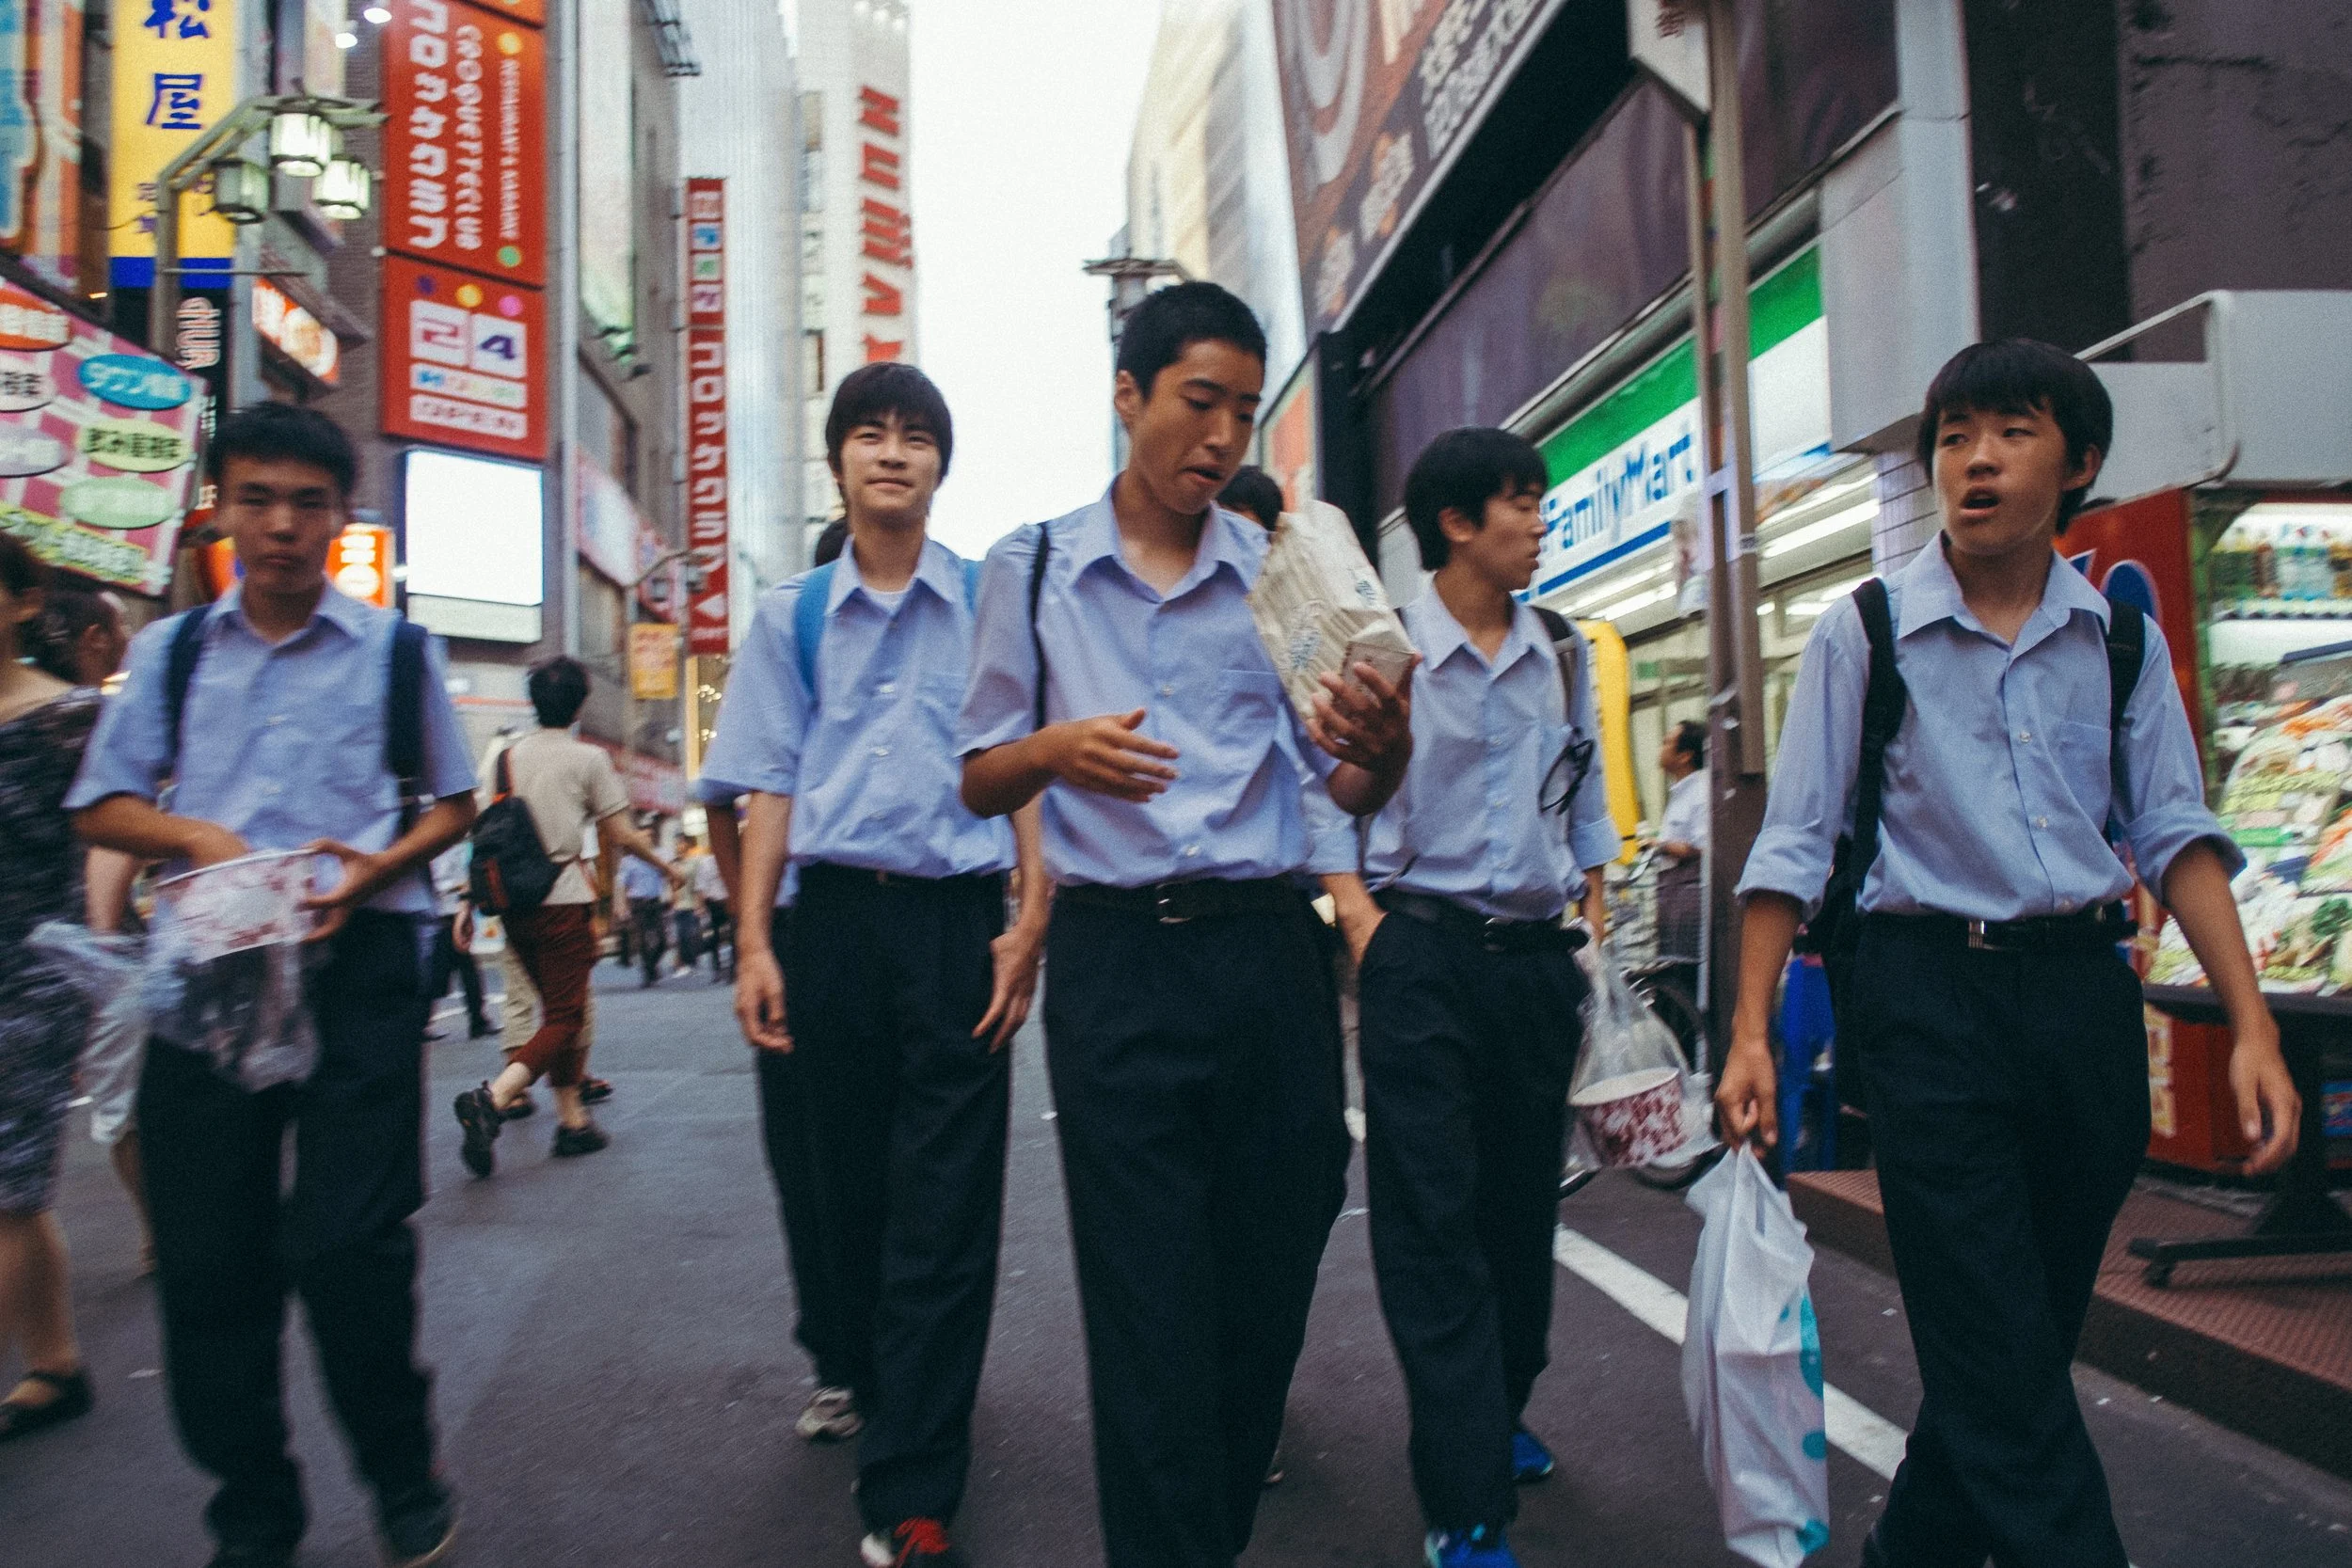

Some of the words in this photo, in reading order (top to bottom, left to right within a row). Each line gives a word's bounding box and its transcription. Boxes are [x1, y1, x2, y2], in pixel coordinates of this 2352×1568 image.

[144, 0, 211, 130] 松屋
[419, 315, 516, 361] 24
[1542, 422, 1695, 552] FamilyMart
